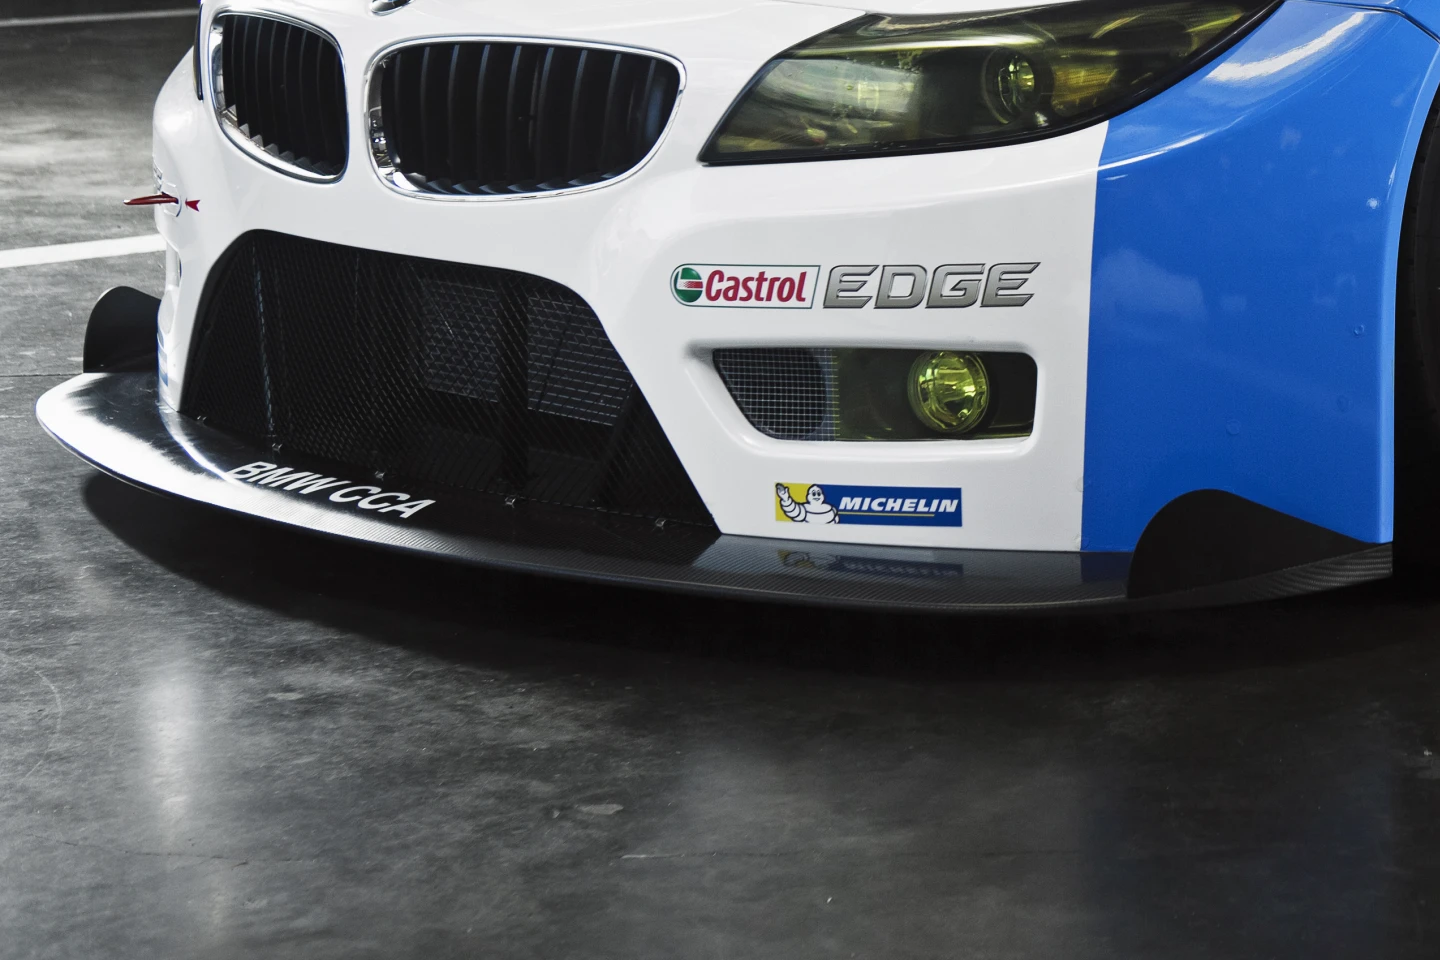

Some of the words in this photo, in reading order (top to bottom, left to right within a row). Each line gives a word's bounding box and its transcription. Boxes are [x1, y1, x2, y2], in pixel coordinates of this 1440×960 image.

[705, 269, 808, 304] Castrol
[822, 262, 1041, 310] EDGE
[226, 461, 352, 495] BMW
[329, 485, 436, 519] CCA
[838, 494, 959, 514] MICHELIN
